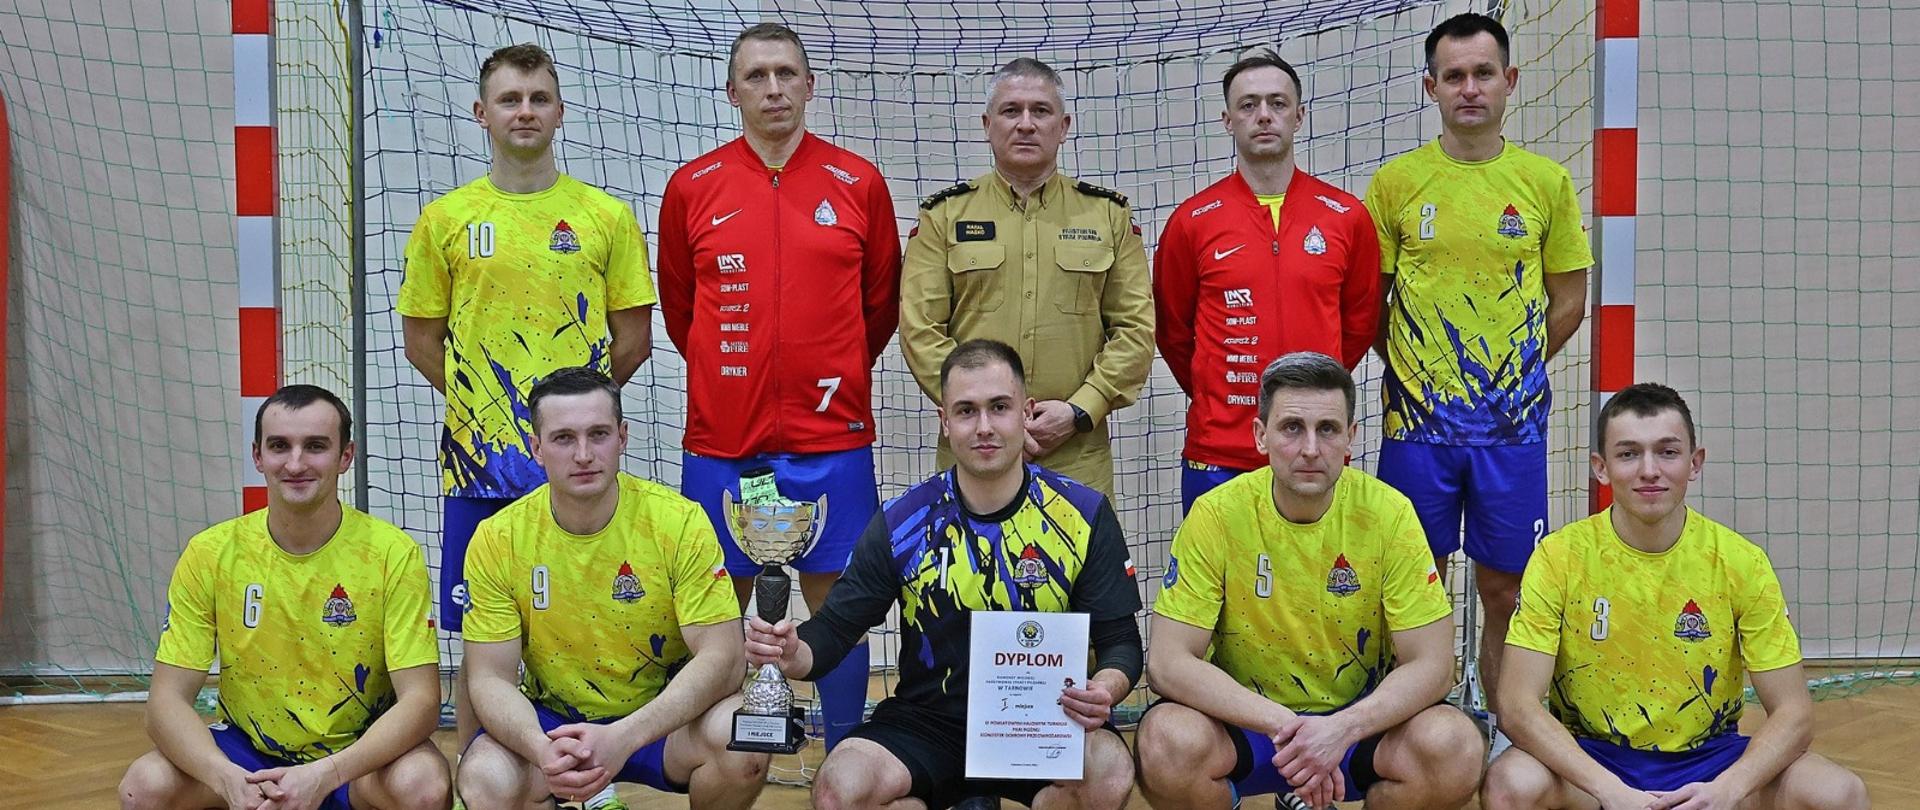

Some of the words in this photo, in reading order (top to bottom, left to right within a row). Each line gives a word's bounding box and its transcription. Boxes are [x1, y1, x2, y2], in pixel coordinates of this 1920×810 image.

[467, 222, 496, 259] 10
[1419, 203, 1436, 240] 2
[815, 376, 842, 412] 7
[1534, 519, 1544, 546] 2
[939, 547, 948, 589] 1
[1254, 552, 1273, 598] 5
[243, 582, 264, 628] 6
[532, 565, 550, 611] 9
[1590, 597, 1609, 641] 3
[994, 652, 1063, 667] DYPLOM
